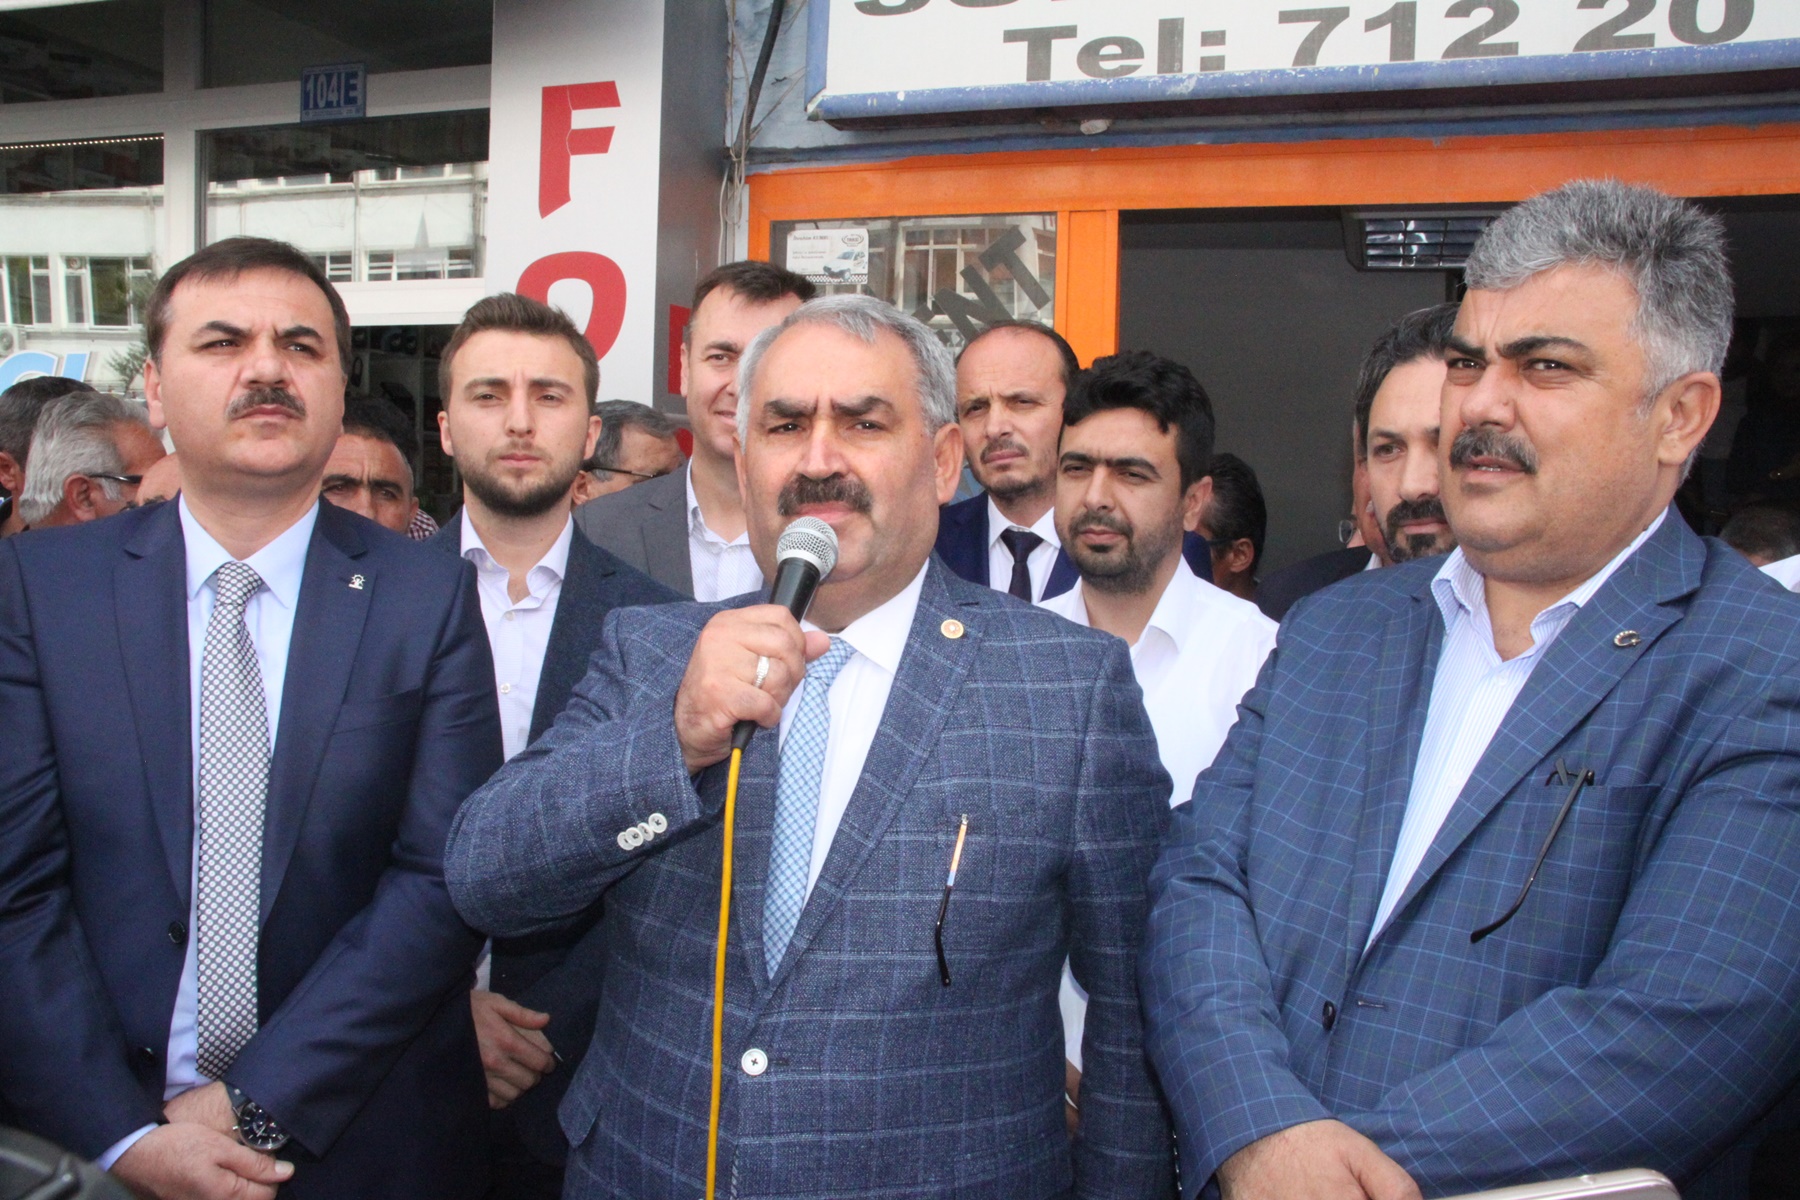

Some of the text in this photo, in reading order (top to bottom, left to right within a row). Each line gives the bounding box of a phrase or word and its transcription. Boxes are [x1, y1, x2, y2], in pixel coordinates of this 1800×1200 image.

[1003, 0, 1755, 82] Tel: 712 20
